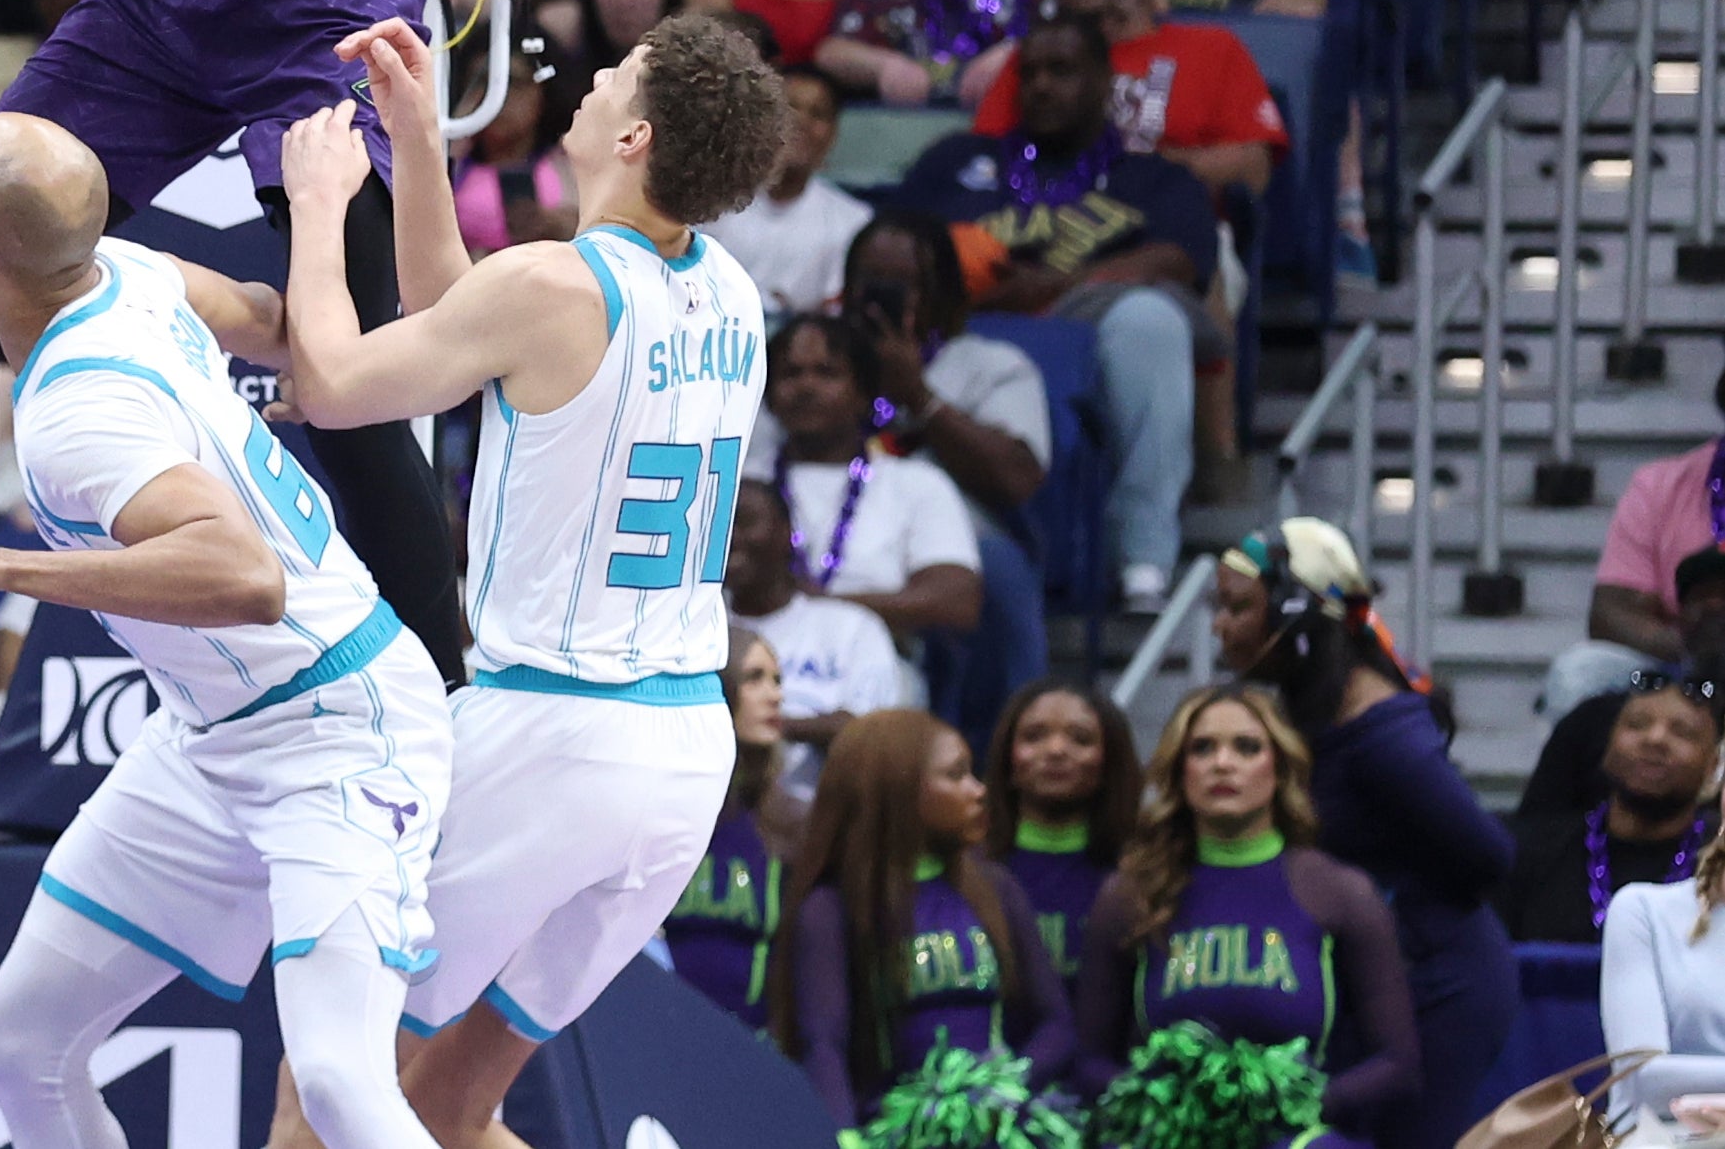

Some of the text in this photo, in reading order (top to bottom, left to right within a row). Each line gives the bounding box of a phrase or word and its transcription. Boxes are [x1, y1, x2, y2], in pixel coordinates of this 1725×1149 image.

[647, 316, 758, 394] SALAÜN
[243, 403, 331, 569] 6
[606, 436, 743, 590] 31
[1162, 922, 1300, 999] NOLA
